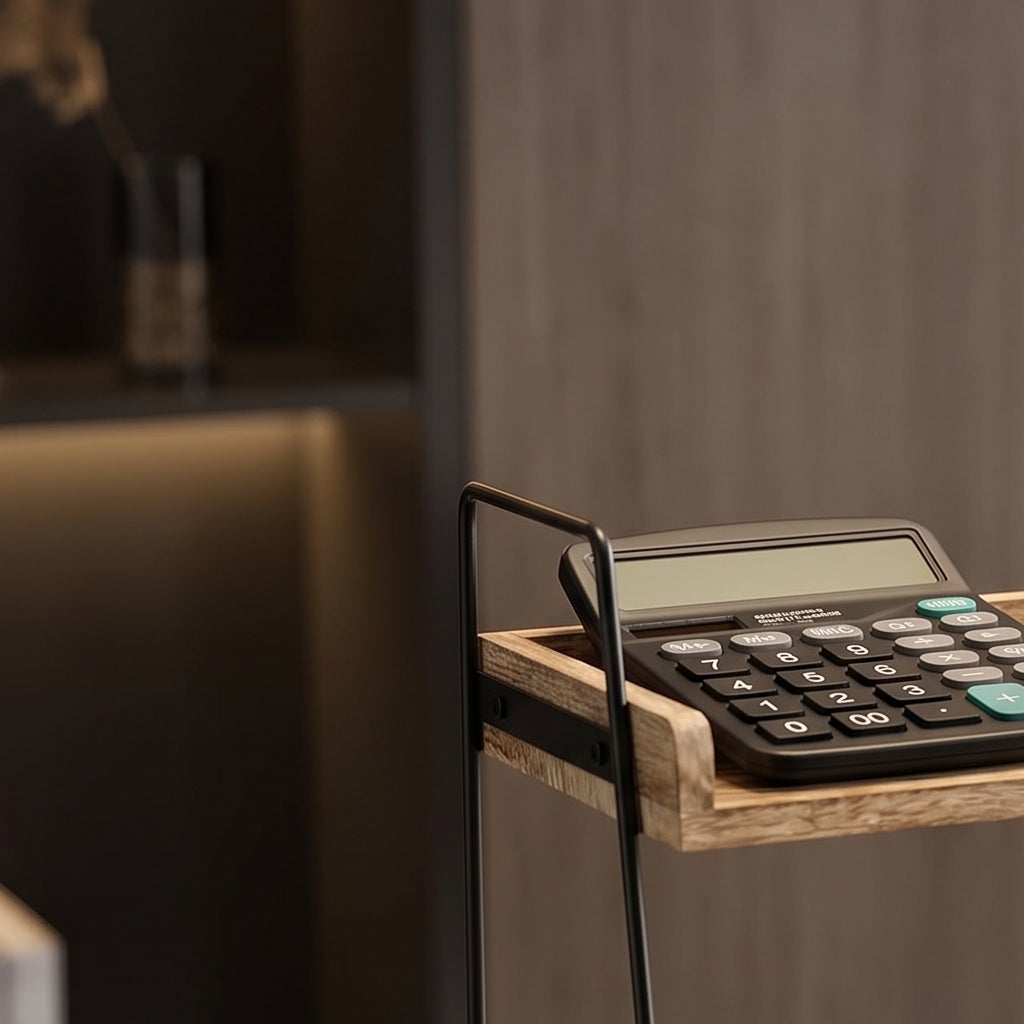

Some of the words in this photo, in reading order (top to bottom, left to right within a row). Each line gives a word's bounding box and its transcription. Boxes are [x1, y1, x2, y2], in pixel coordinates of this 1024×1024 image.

[701, 658, 719, 671] 7
[776, 652, 799, 663] 8
[846, 644, 869, 655] 9
[733, 679, 753, 691] 4
[802, 671, 825, 683] 5
[873, 664, 897, 675] 6
[759, 700, 779, 711] 1
[829, 692, 855, 704] 2
[902, 684, 926, 696] 3
[784, 721, 808, 733] 0
[848, 711, 890, 726] 00
